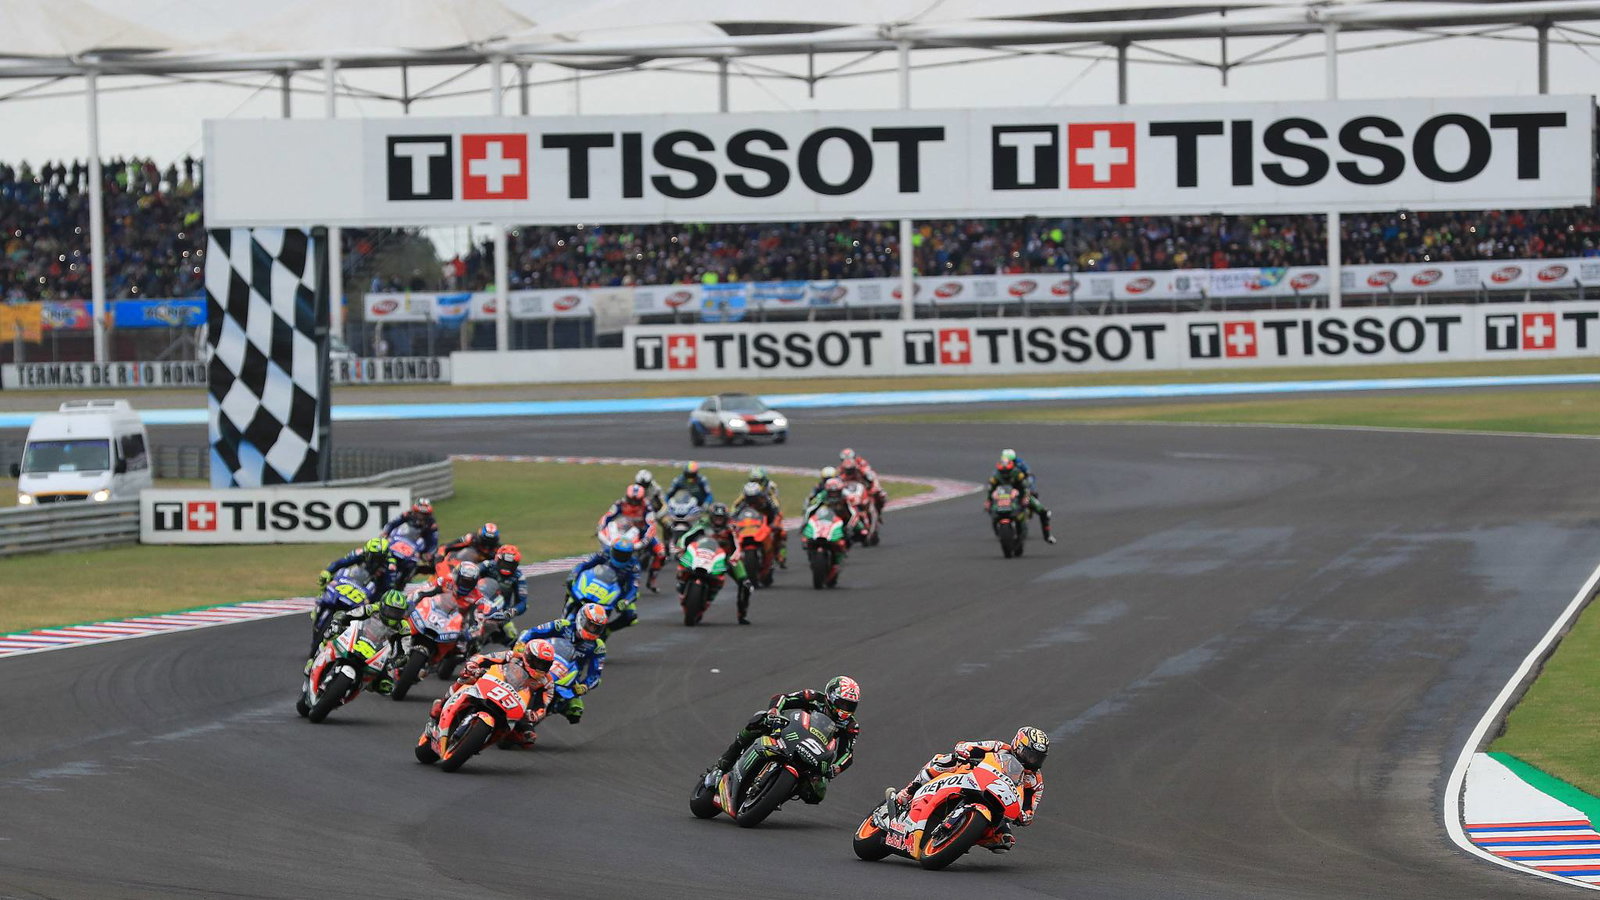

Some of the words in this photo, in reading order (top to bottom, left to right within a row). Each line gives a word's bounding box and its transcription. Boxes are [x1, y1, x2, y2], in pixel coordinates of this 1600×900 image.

[542, 127, 945, 199] TISSOT
[1150, 112, 1567, 187] TISSOT
[704, 331, 882, 369] TISSOT
[977, 324, 1165, 364] TISSOT
[1263, 317, 1461, 357] TISSOT
[17, 362, 84, 386] TERMAS
[90, 361, 111, 385] DE
[383, 360, 440, 381] HONDO
[222, 500, 401, 532] TISSOT
[334, 583, 367, 604] 46
[486, 686, 518, 710] 93
[800, 738, 825, 756] 5
